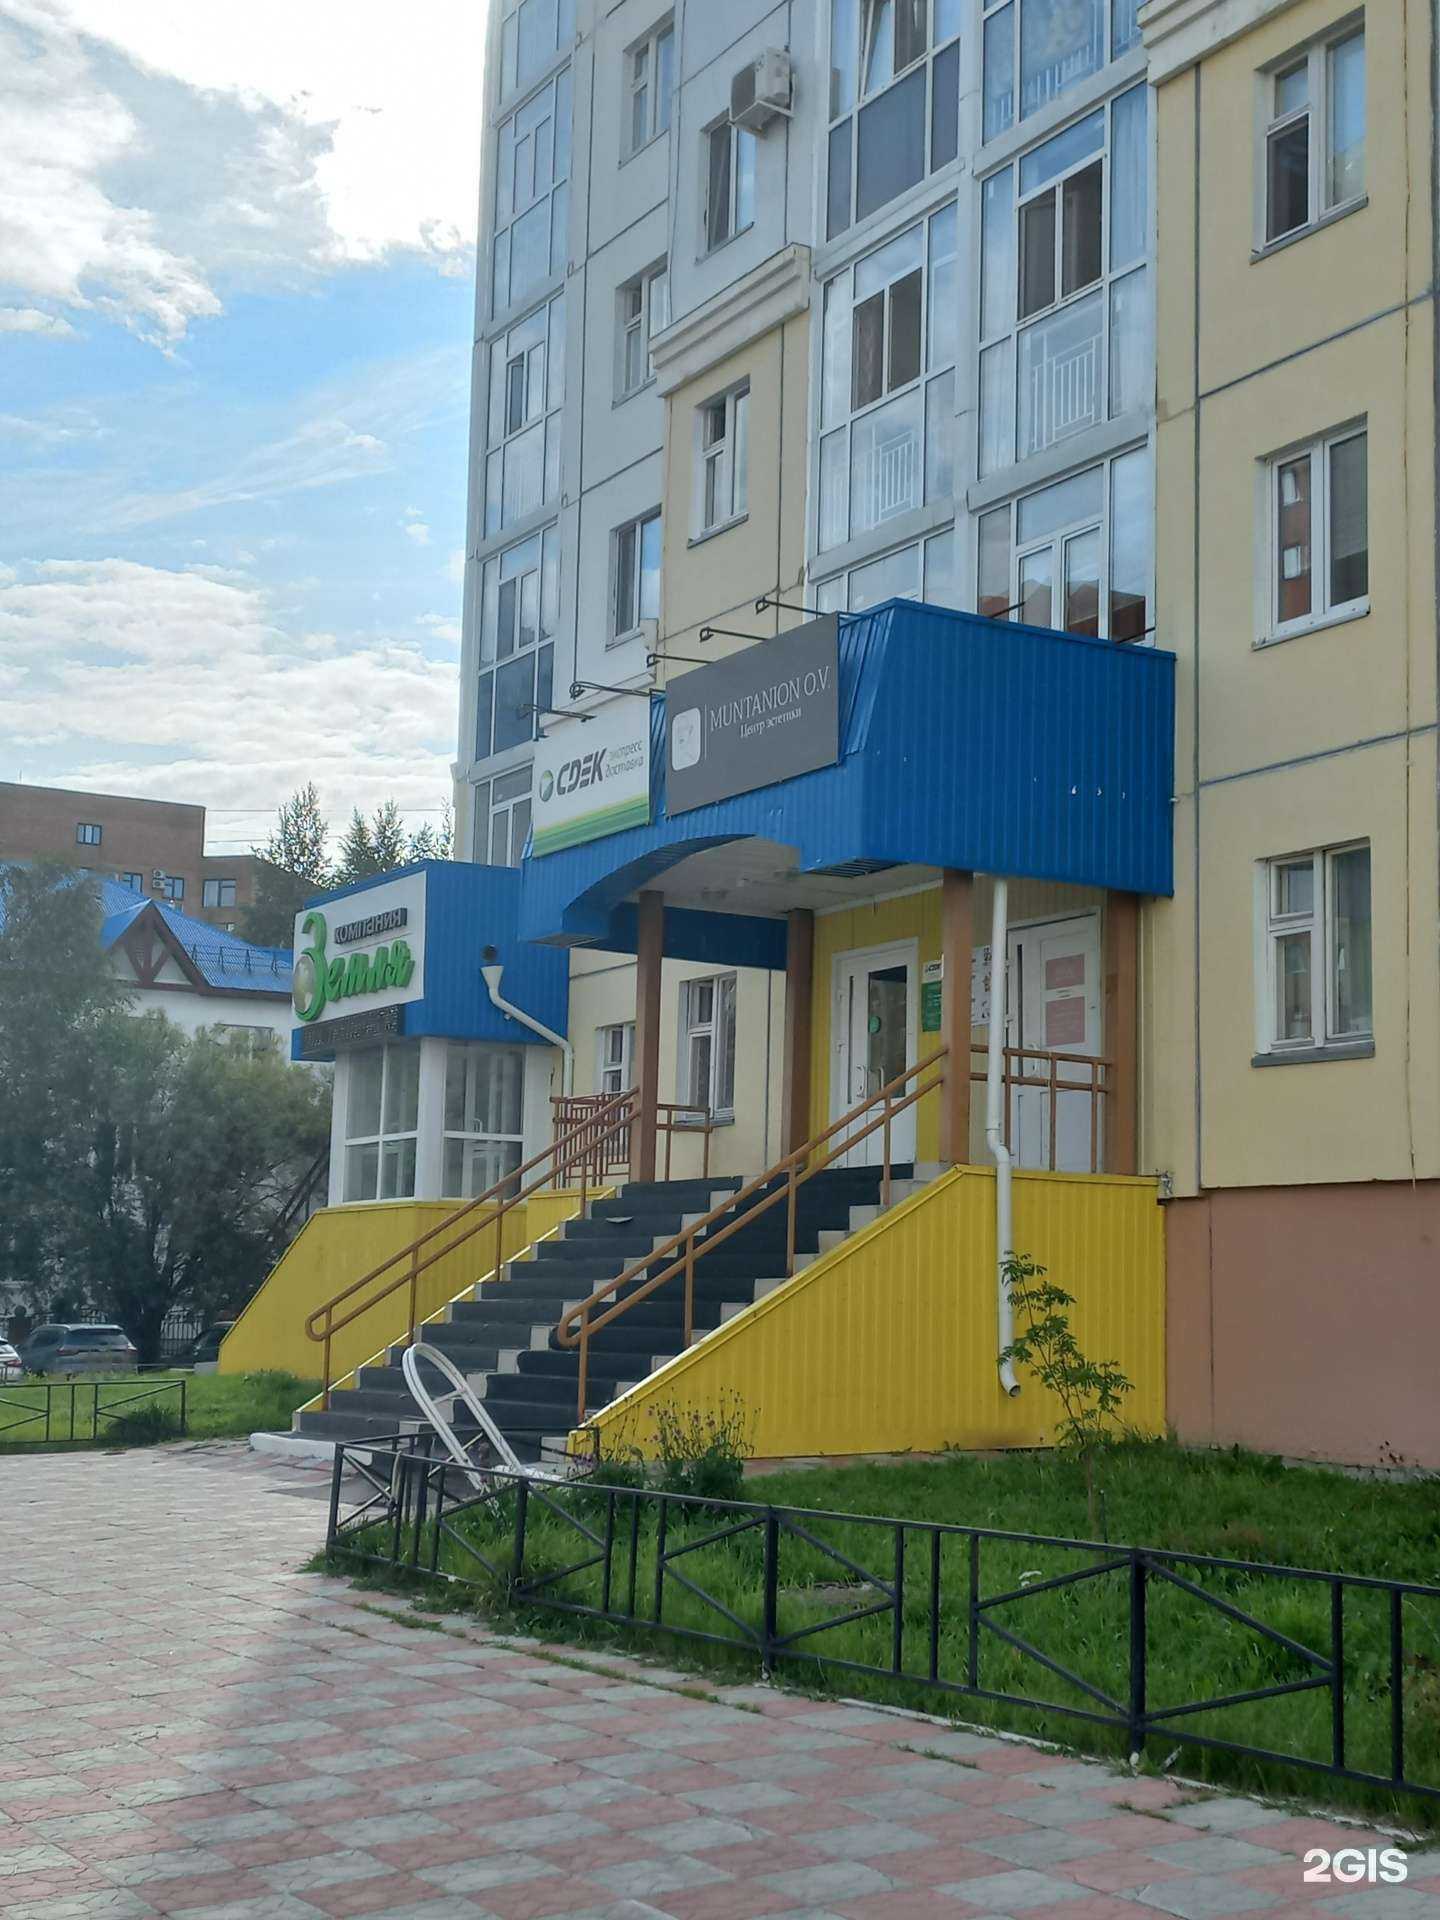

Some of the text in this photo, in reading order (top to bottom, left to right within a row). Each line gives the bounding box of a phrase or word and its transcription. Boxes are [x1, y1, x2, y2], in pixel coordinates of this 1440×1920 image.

[709, 677, 801, 732] MUNTANION
[740, 720, 766, 738] Центр
[556, 746, 608, 796] CDEK
